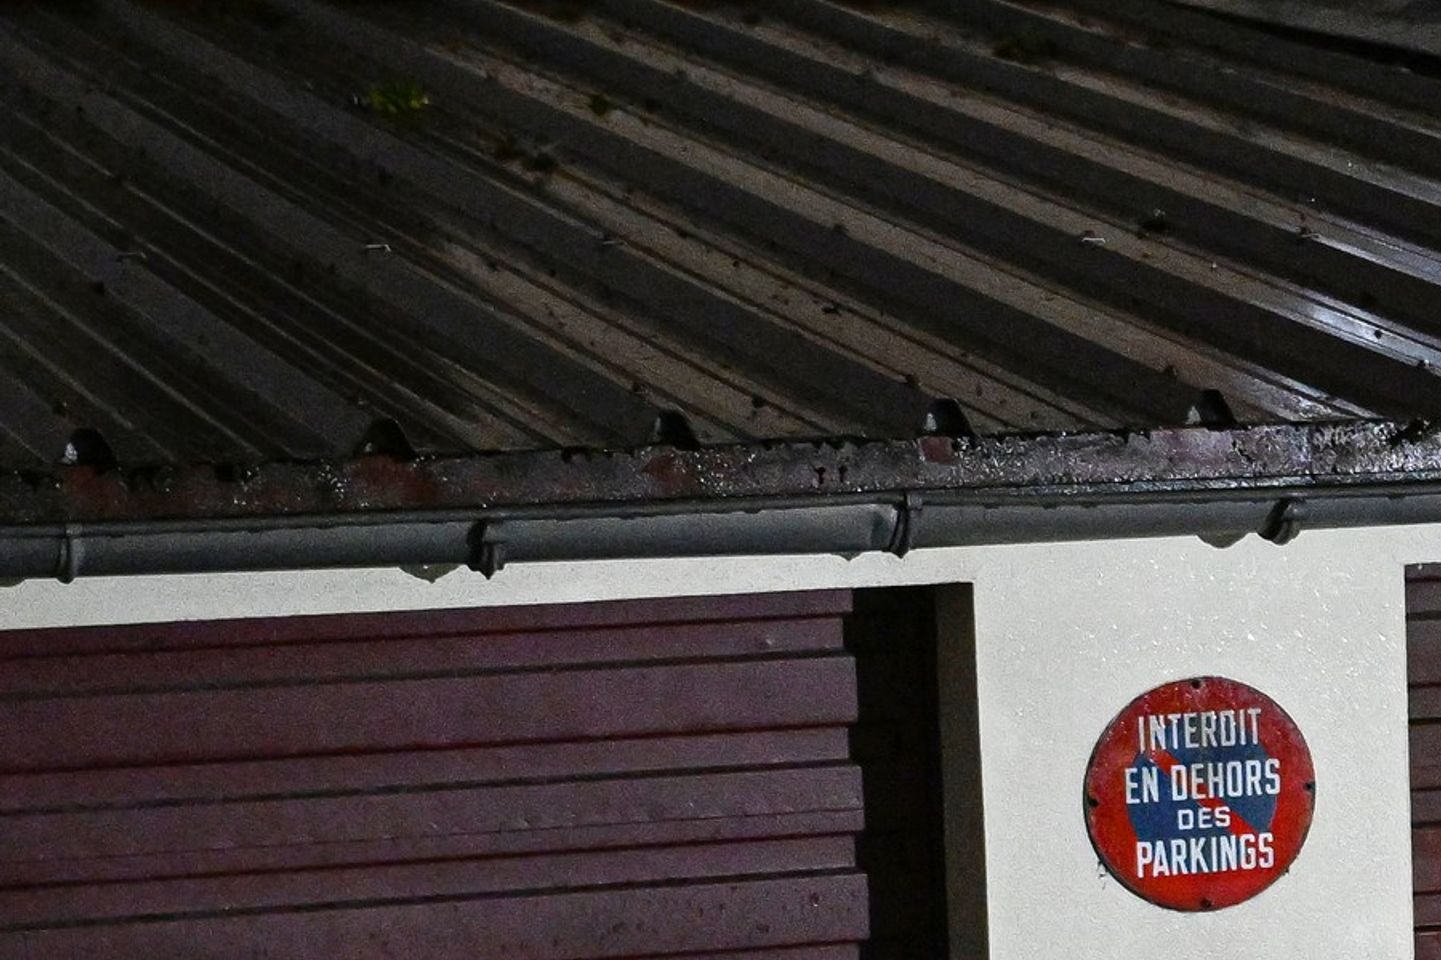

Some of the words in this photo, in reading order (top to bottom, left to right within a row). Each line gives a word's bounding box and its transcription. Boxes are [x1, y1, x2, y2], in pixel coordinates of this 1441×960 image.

[1138, 708, 1261, 753] INTERDIT
[1125, 766, 1159, 804] EN
[1170, 758, 1281, 801] DEHORS
[1177, 806, 1231, 830] DES
[1136, 832, 1274, 878] PARKINGS
